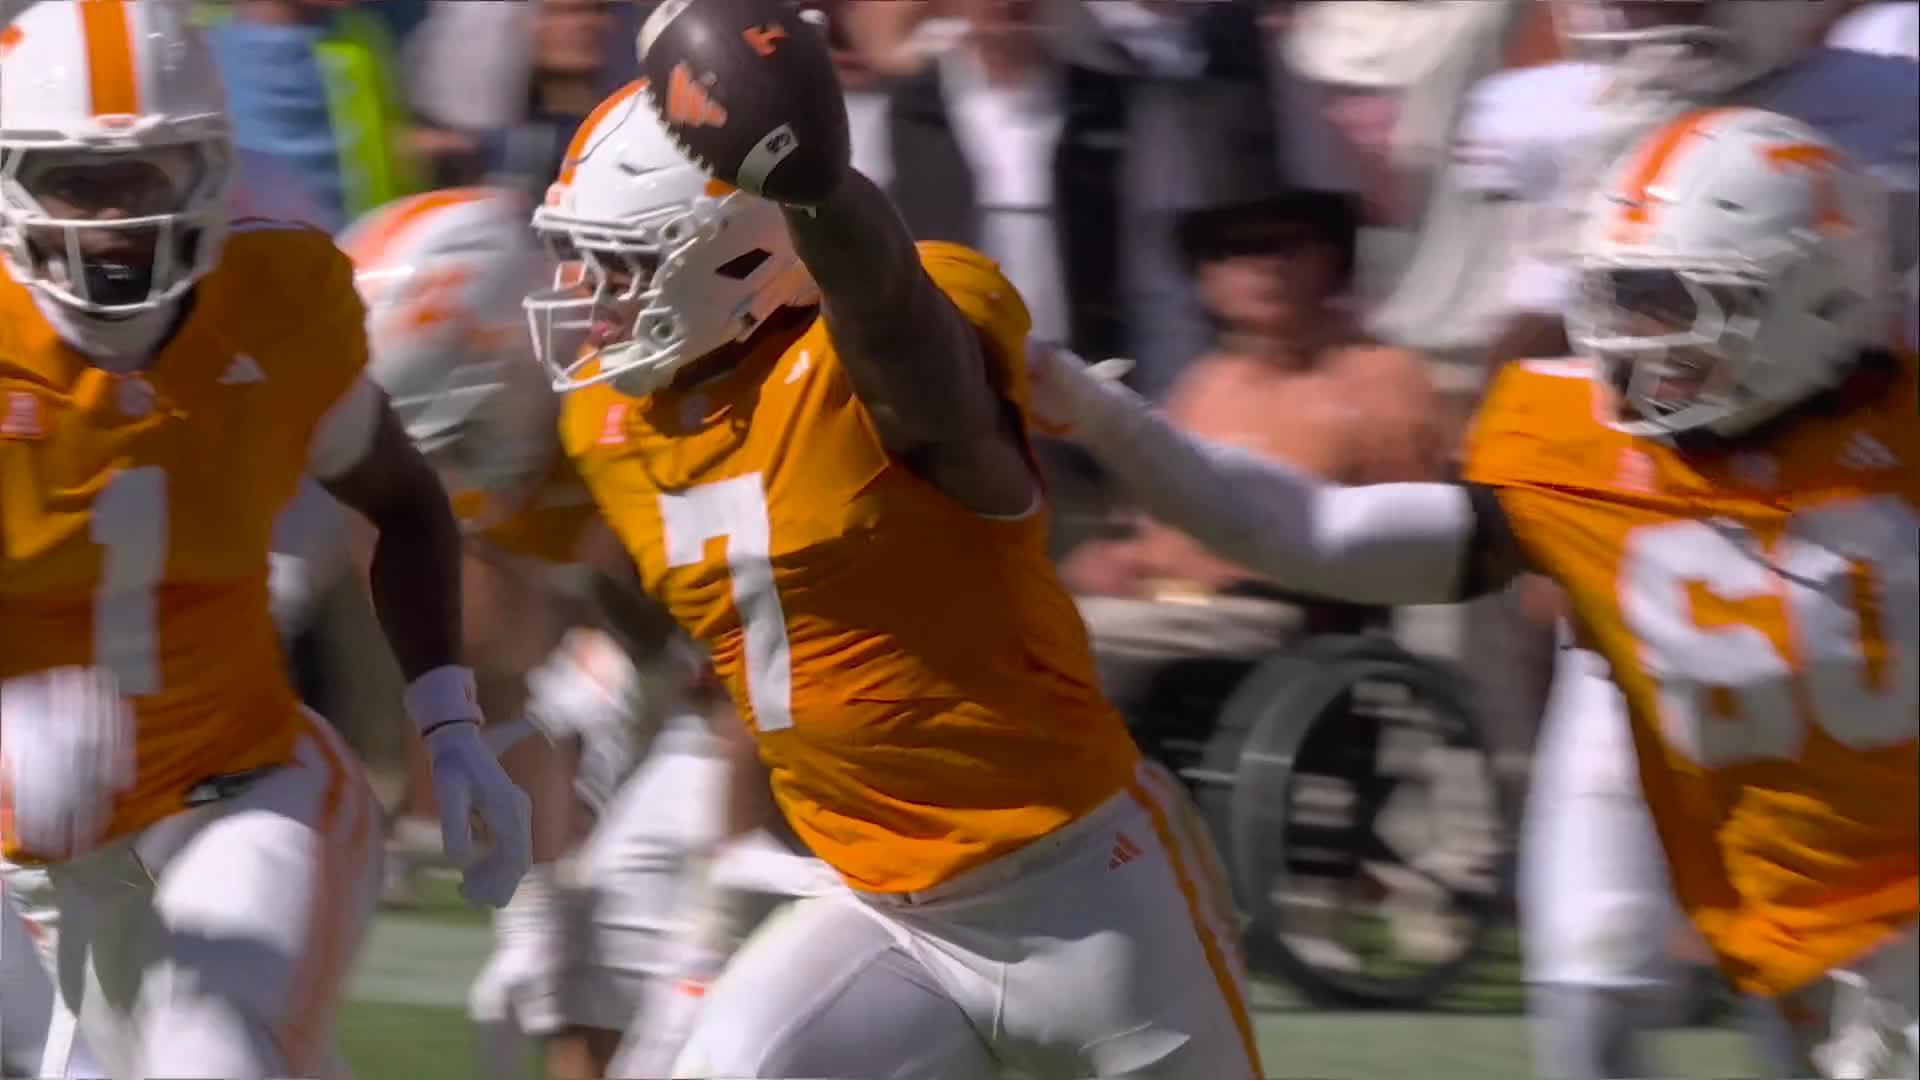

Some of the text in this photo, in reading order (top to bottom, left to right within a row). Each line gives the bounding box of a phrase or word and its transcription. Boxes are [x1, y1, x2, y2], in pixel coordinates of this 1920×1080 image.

[90, 466, 168, 695] 1
[657, 472, 794, 732] 7
[1615, 493, 1919, 767] 60
